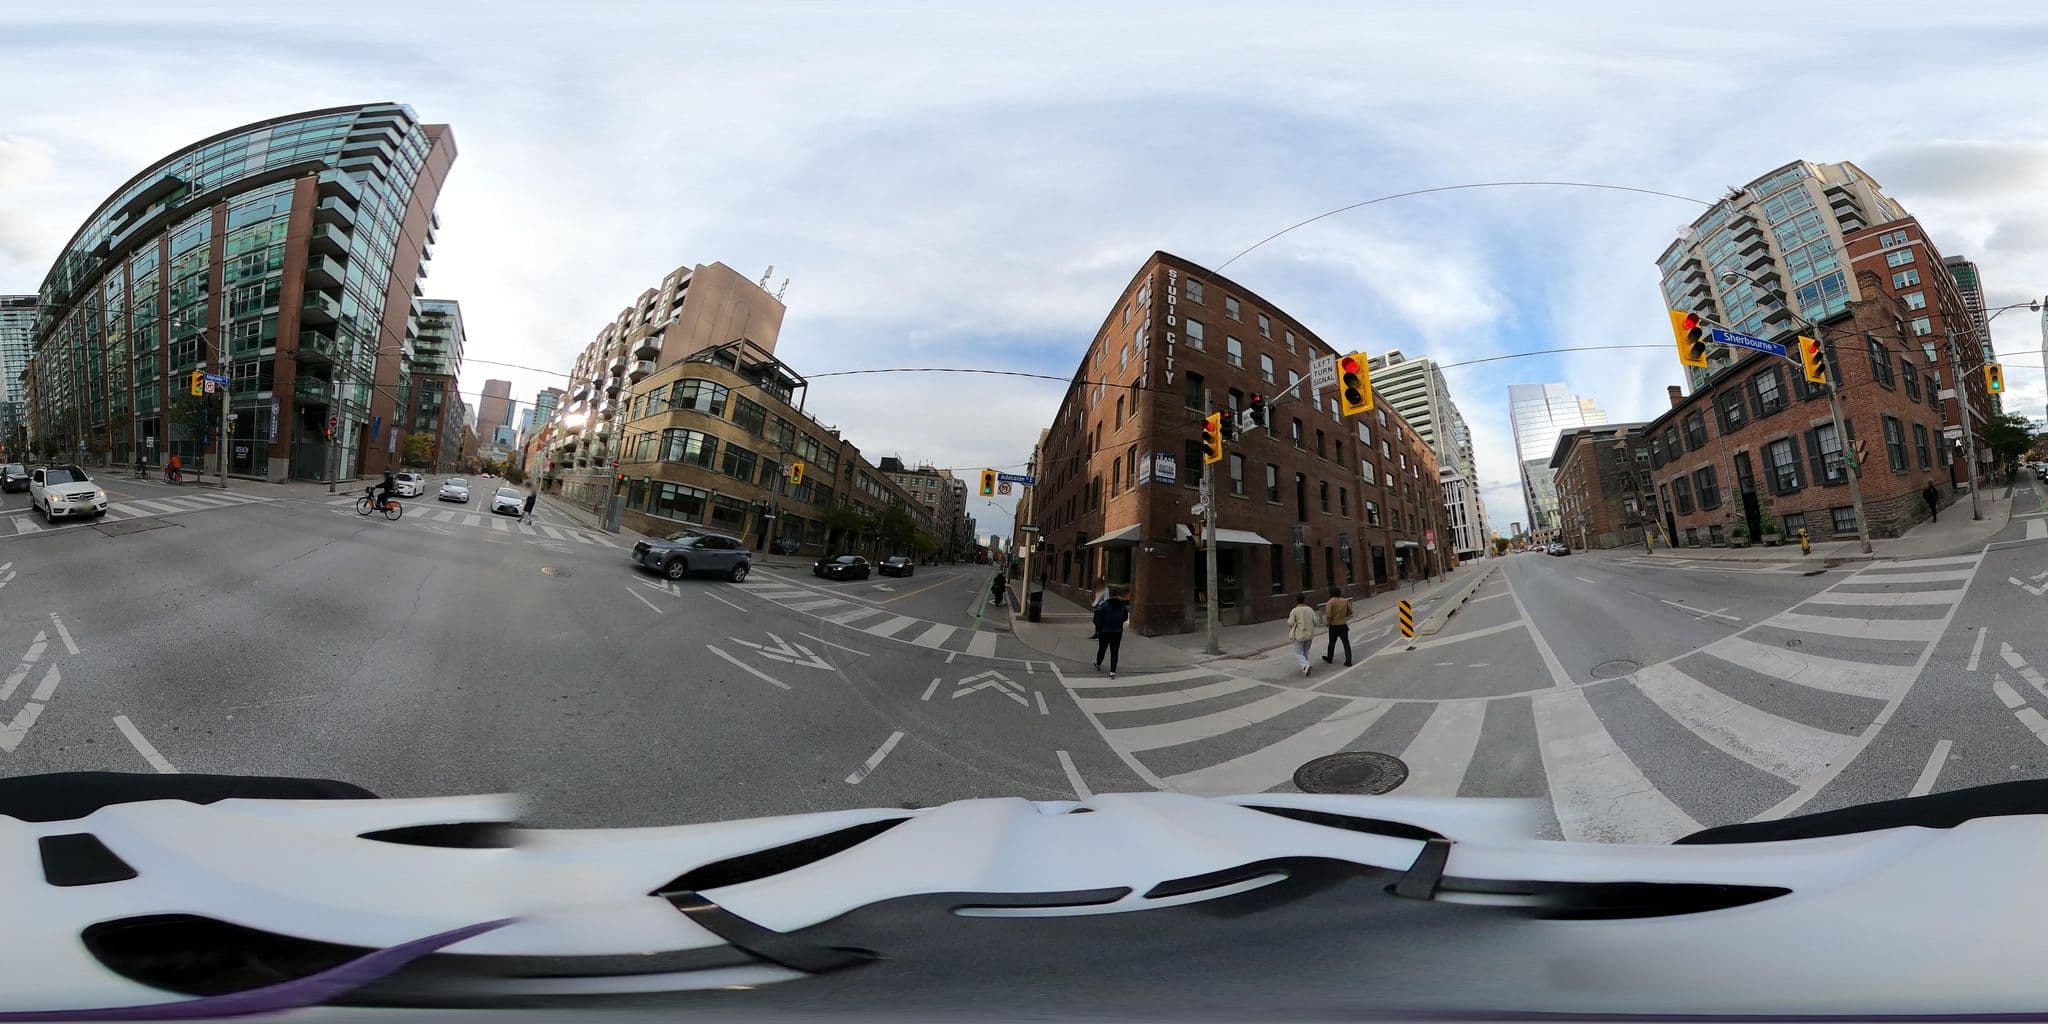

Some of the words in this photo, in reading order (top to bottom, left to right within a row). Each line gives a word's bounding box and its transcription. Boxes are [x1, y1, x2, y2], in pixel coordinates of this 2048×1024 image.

[1144, 272, 1153, 330] STUDIO
[1167, 269, 1177, 327] STUDIO
[1723, 332, 1772, 351] Sherbourne
[1142, 335, 1150, 388] CITY
[1165, 331, 1176, 385] CITY
[1313, 358, 1330, 369] LEFT
[1313, 375, 1335, 386] SIGNAL
[1314, 366, 1333, 377] TURN
[1000, 474, 1024, 482] Adelaide
